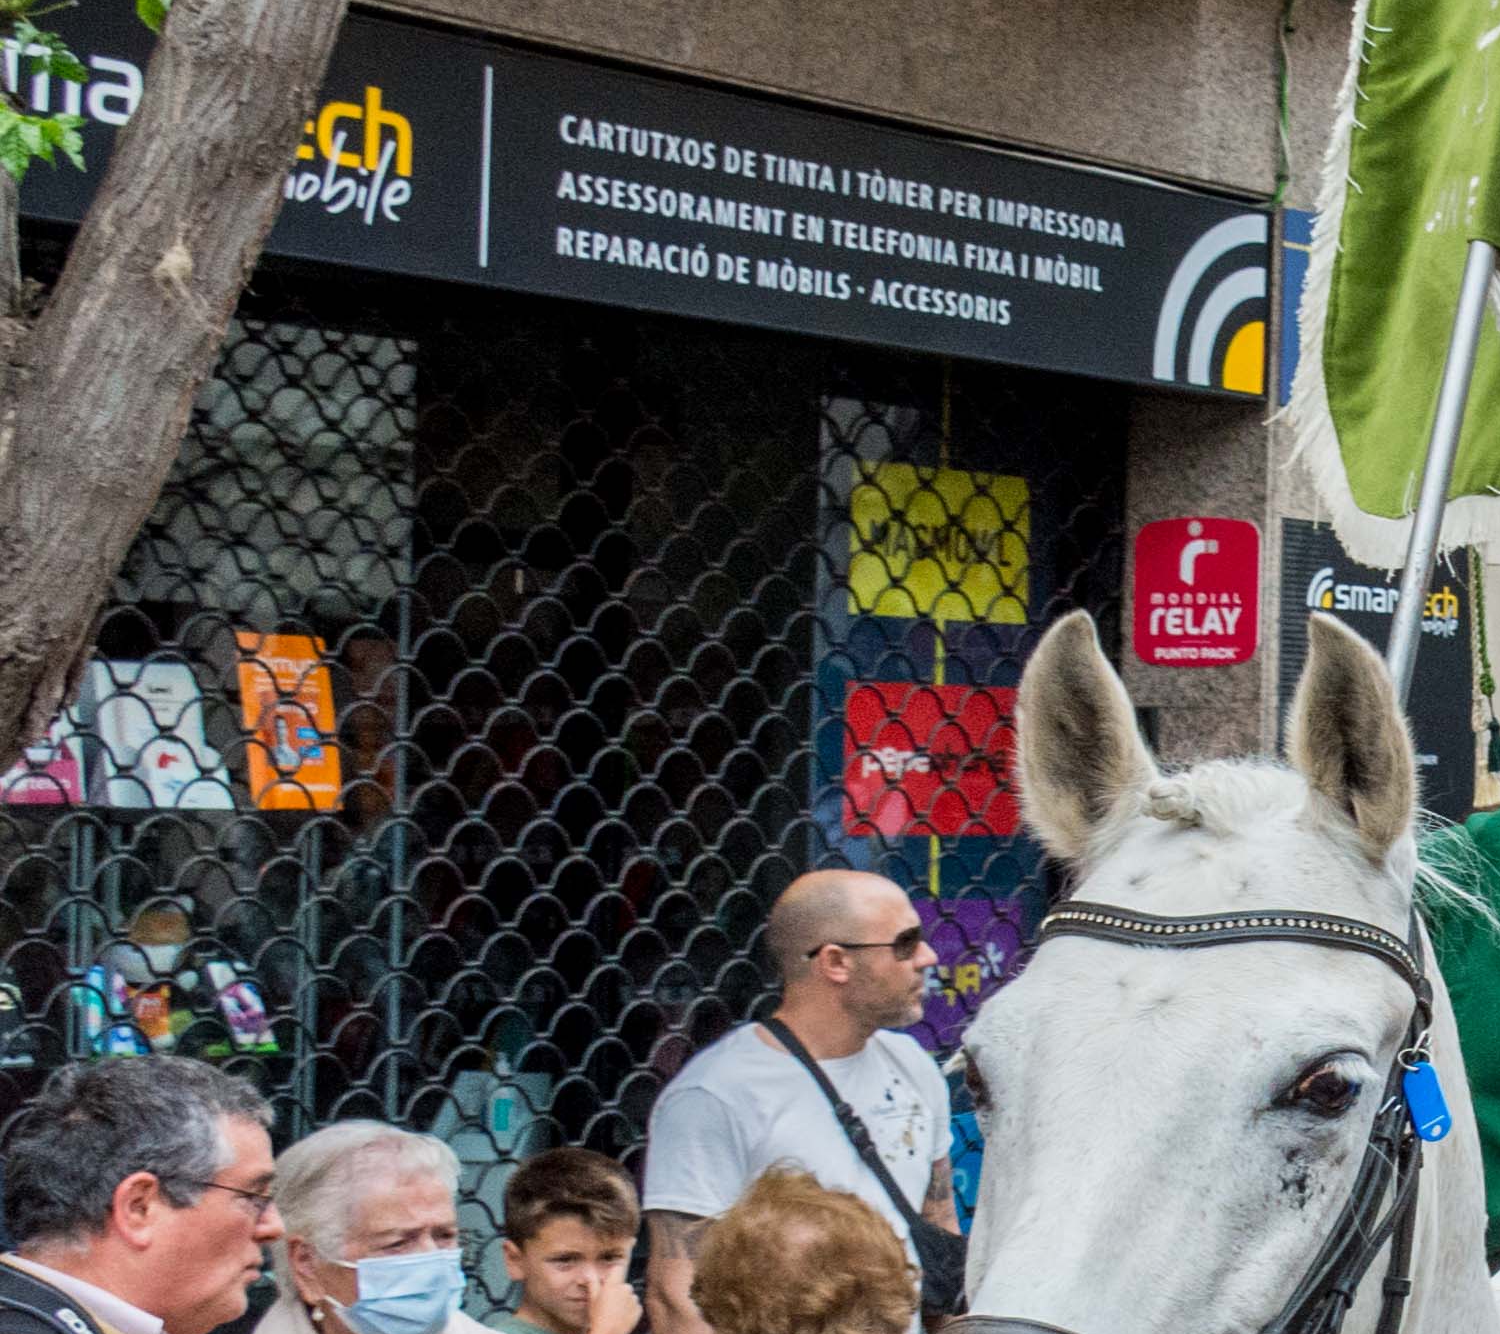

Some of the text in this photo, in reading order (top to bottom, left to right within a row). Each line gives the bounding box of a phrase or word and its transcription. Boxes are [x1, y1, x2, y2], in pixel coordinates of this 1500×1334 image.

[556, 170, 1103, 292] ASSESSORAMENT EN TELEFONIA FIXA I MÒBIL
[559, 114, 1125, 248] CARTUTXOS DE TINTA I TÒNER PER IMPRESSORA
[556, 226, 1011, 326] REPARACIÓ DE MÒBILS ACCESSORIS
